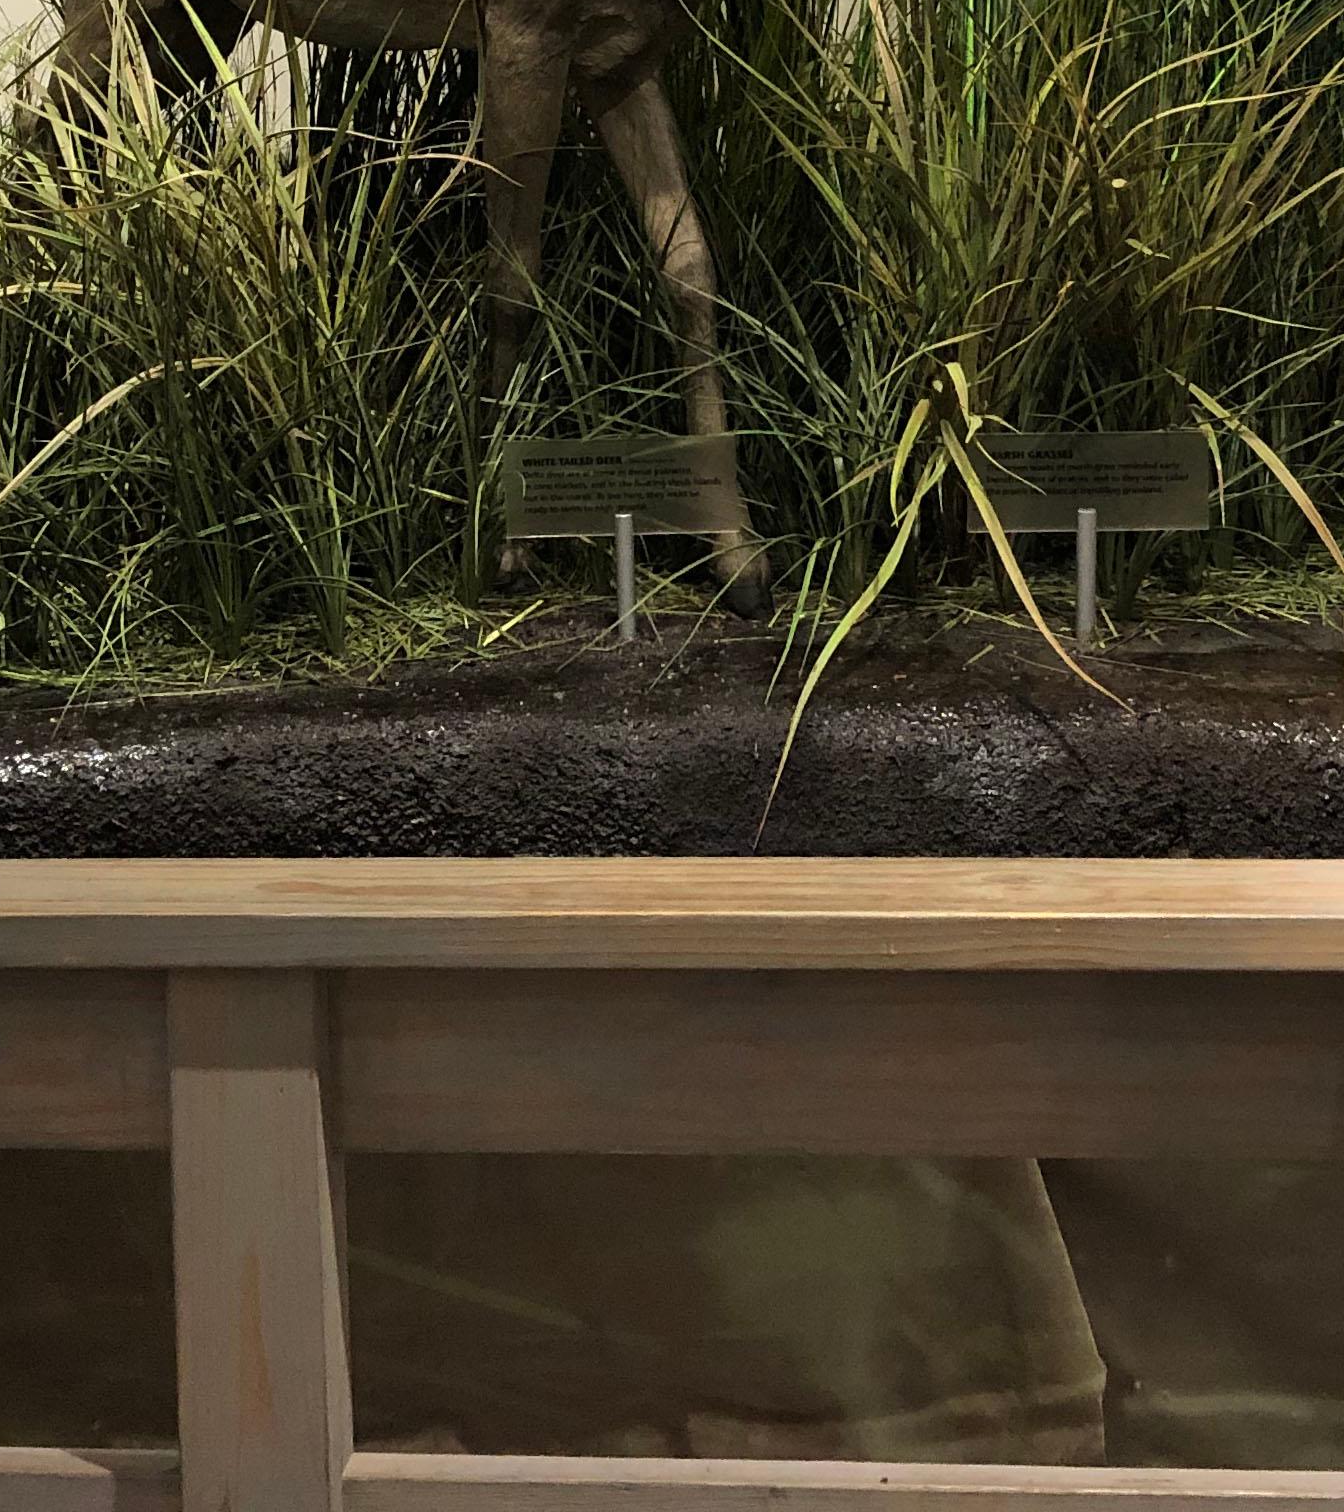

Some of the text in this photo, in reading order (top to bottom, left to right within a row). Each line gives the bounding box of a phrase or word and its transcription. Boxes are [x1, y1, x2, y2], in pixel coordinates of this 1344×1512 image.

[522, 456, 622, 467] WHITE TAILED DEER
